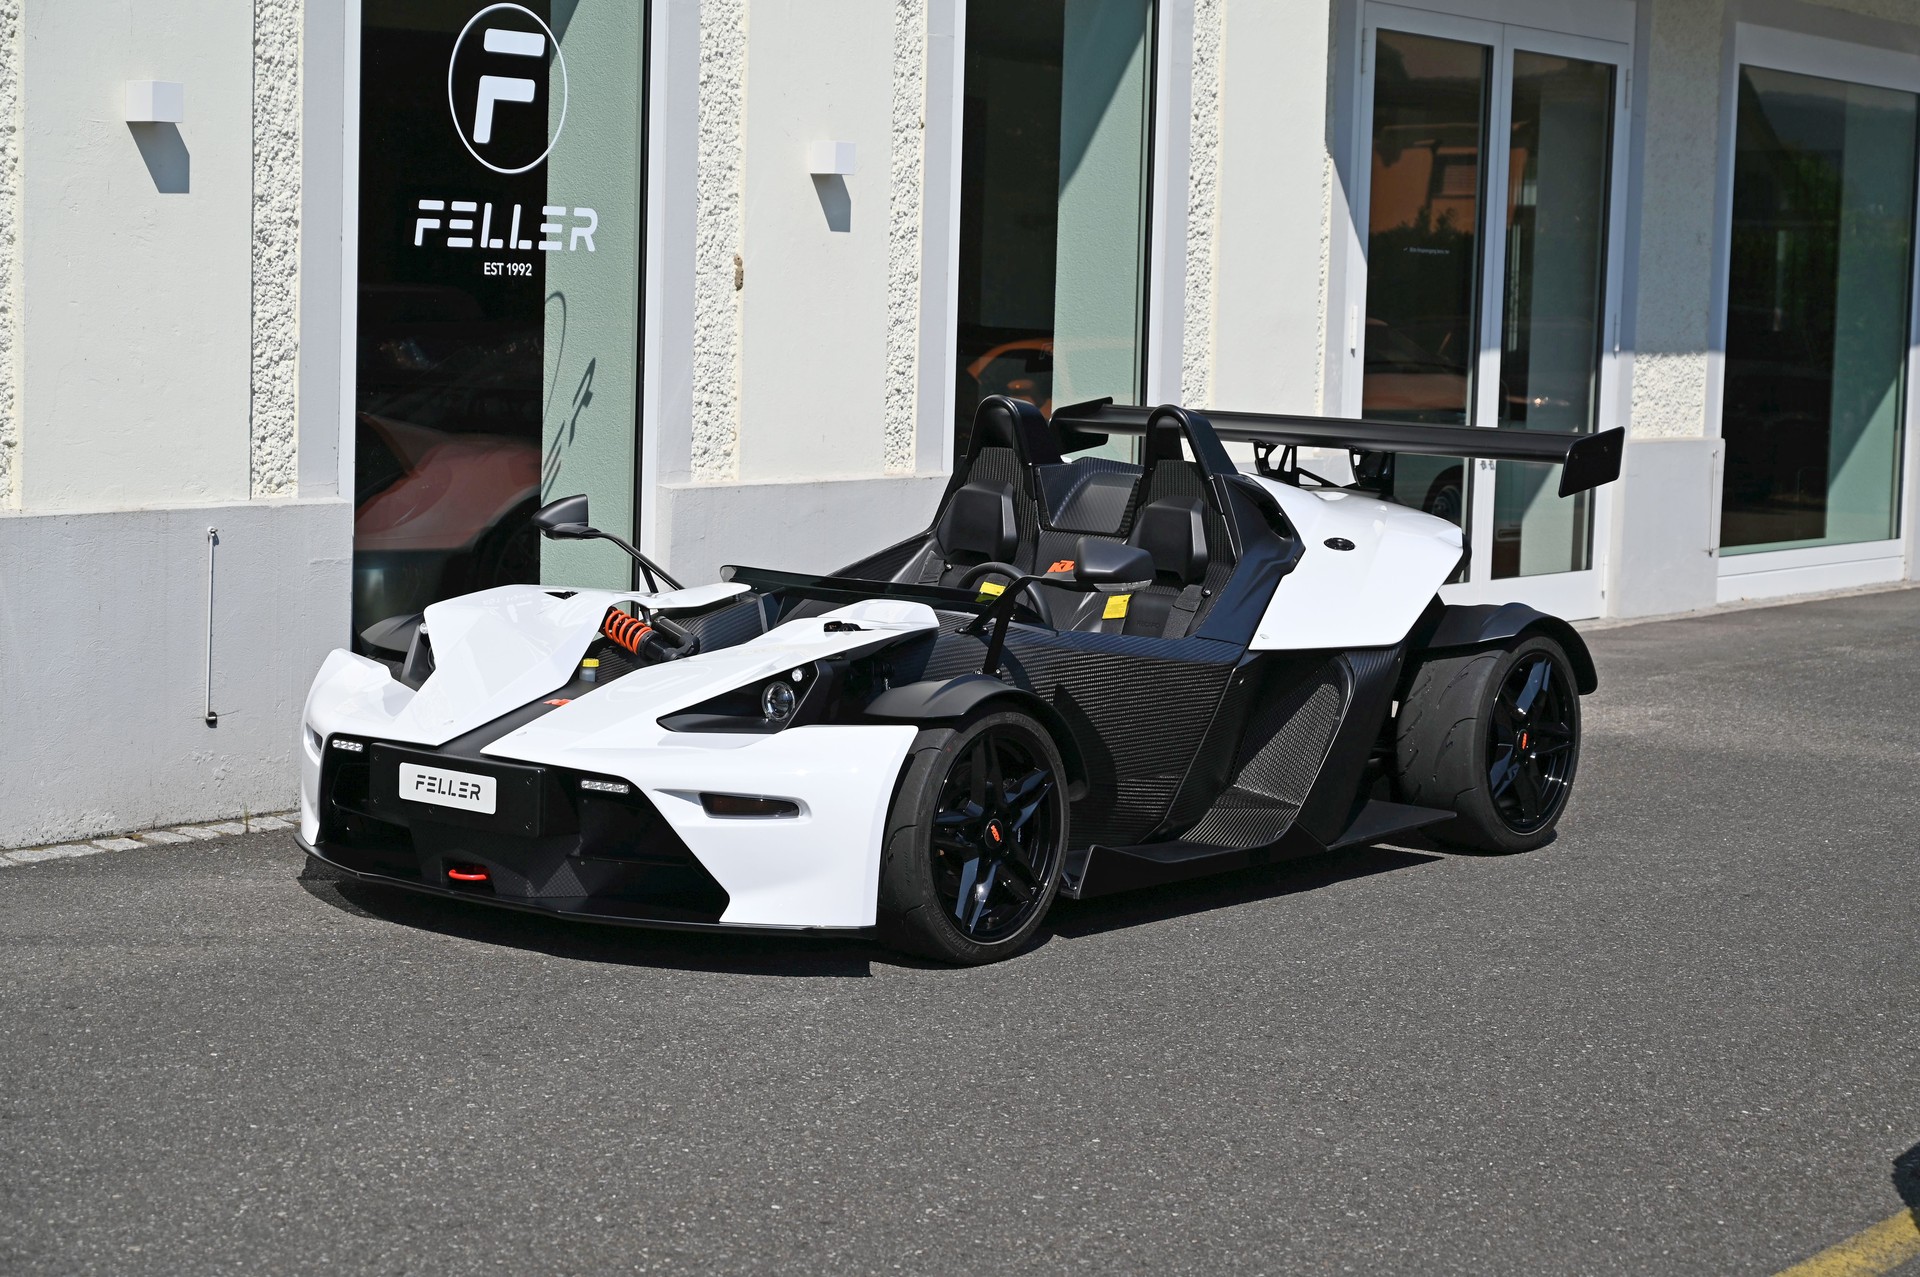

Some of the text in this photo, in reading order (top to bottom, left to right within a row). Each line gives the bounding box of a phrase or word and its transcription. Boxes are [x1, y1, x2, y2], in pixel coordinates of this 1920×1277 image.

[414, 199, 598, 252] FELLER
[483, 262, 533, 277] EST 1992
[1047, 559, 1075, 573] KT
[415, 774, 481, 801] FELLER
